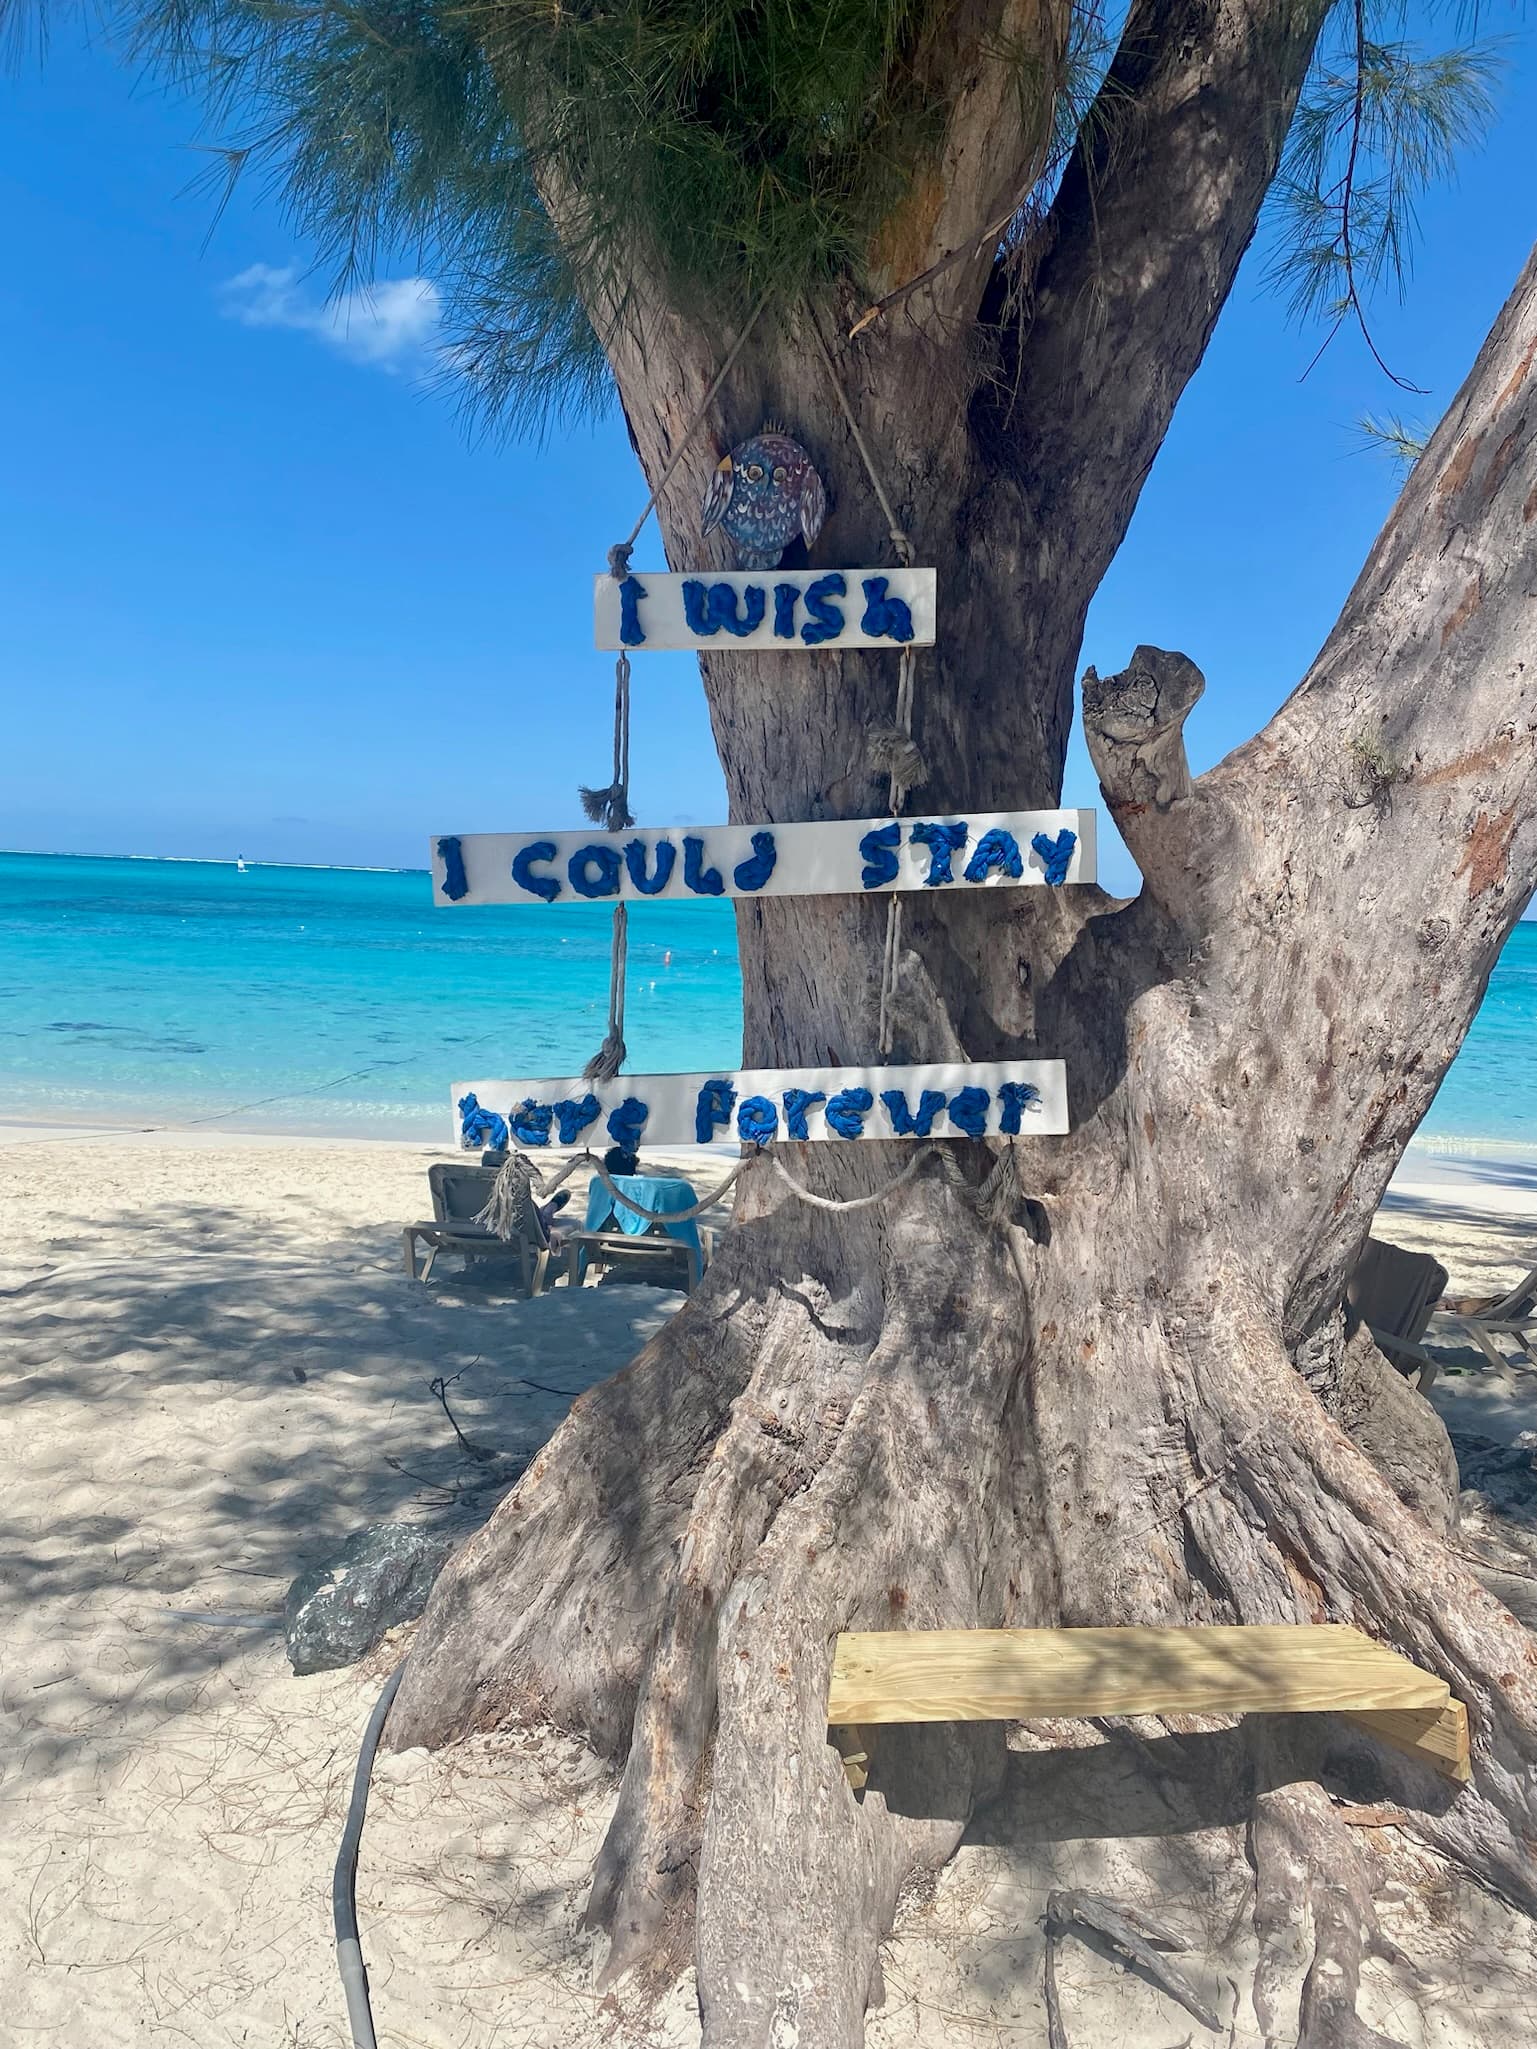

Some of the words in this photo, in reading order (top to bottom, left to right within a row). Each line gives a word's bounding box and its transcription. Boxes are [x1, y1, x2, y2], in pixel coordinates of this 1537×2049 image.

[619, 575, 648, 646] I
[438, 837, 469, 901] I
[859, 821, 1077, 889] STAY
